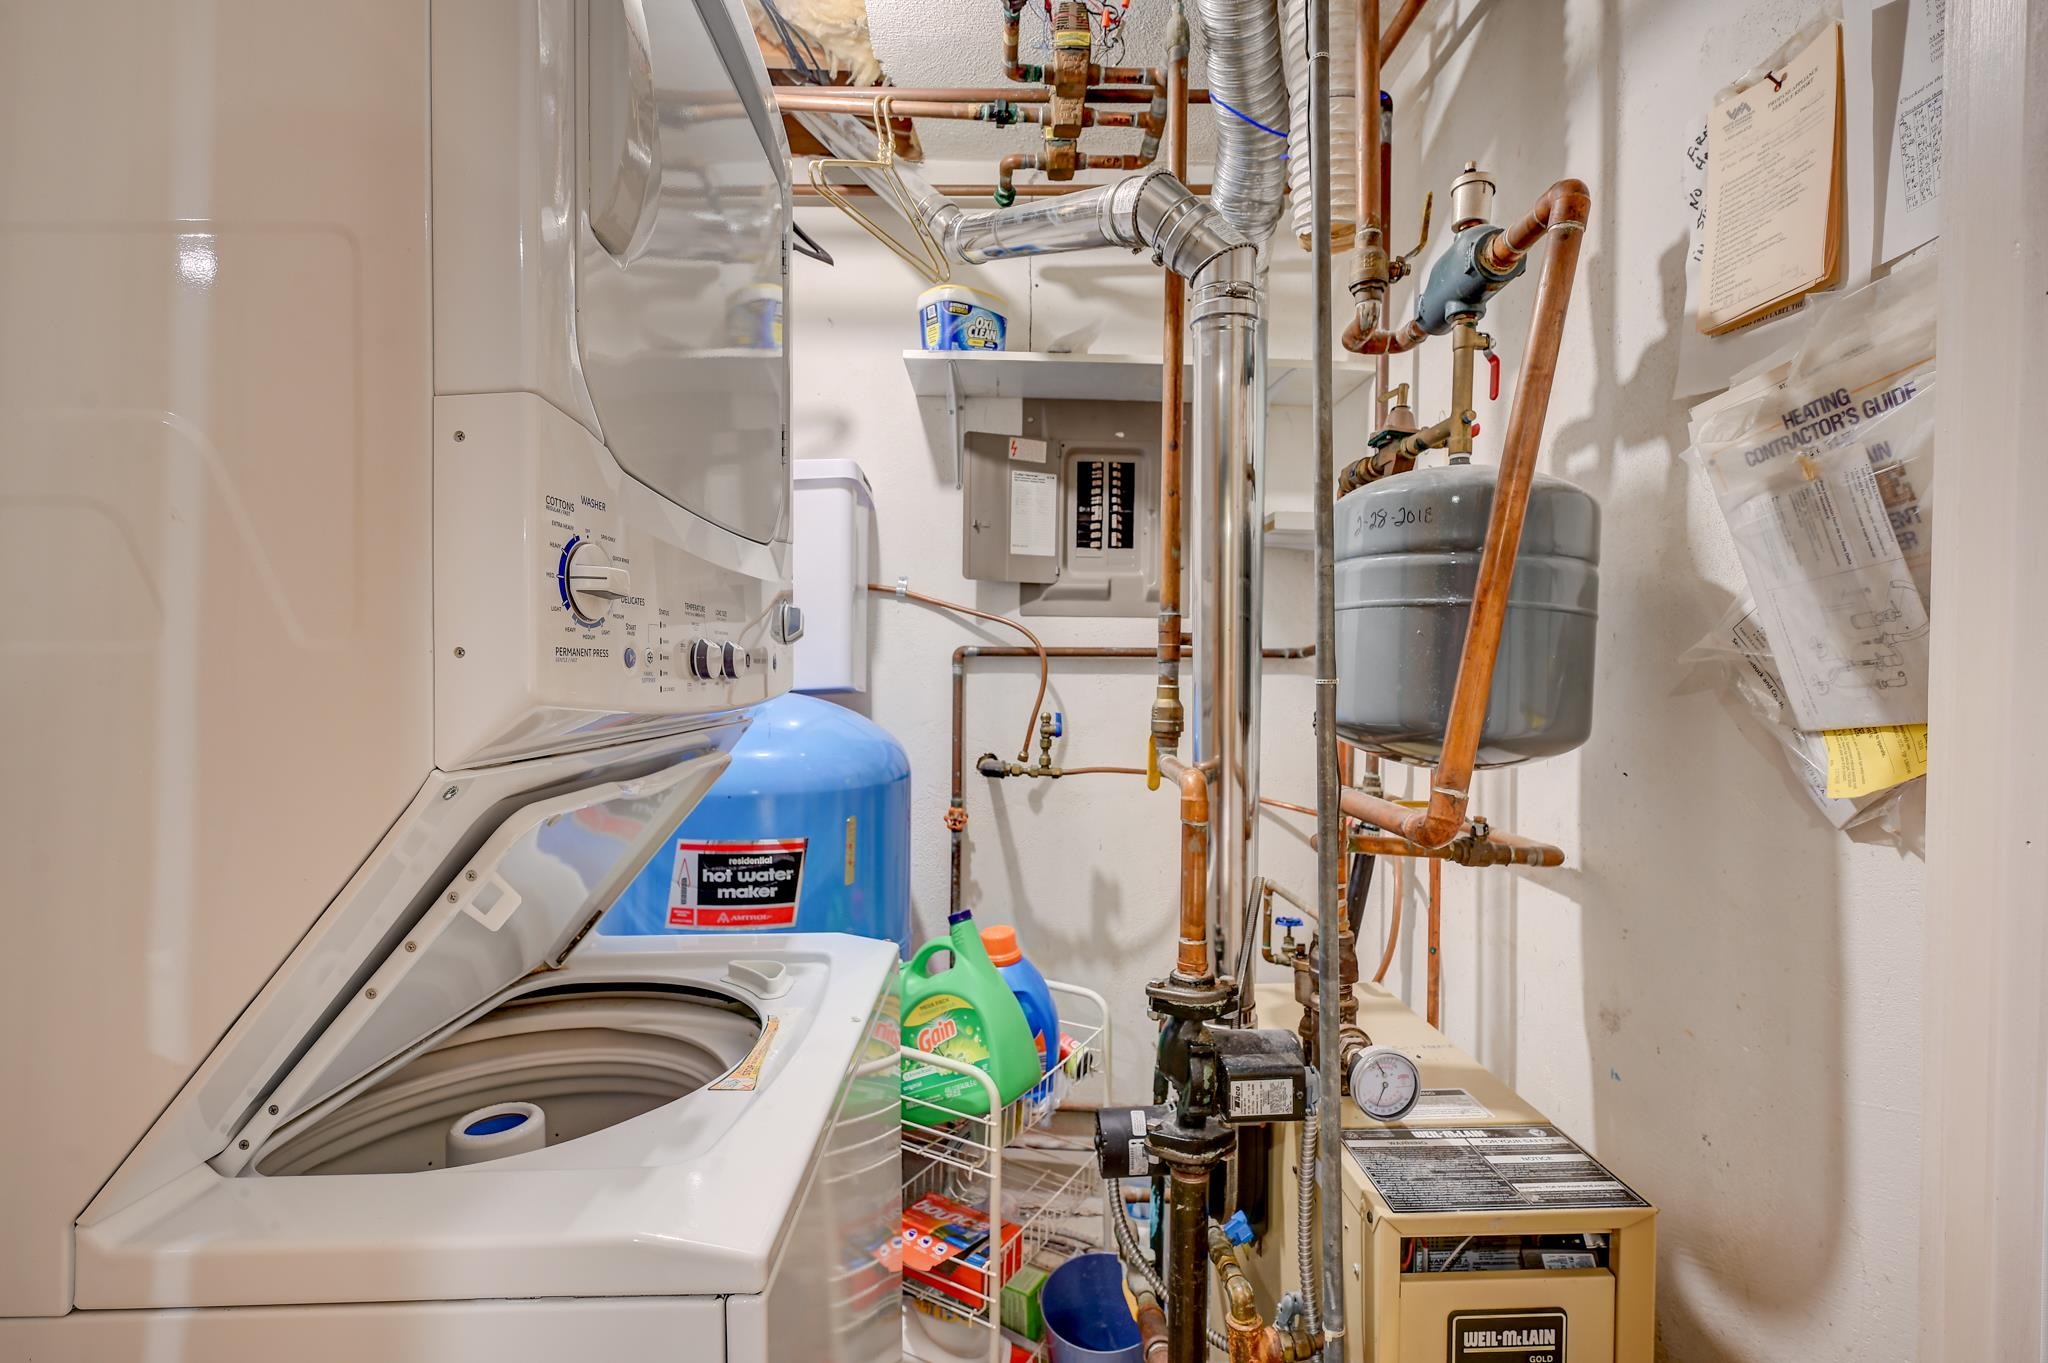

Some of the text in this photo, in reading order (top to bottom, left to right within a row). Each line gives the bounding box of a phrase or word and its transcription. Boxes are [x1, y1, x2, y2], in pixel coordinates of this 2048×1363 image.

[975, 316, 993, 329] OXI
[967, 324, 997, 340] CLEAN
[1782, 388, 1852, 430] HEATING
[1745, 407, 1860, 468] CONTRACTOR'S
[545, 495, 606, 512] COTTONS WASHER
[551, 520, 575, 531] EXTRA HEAVY
[549, 541, 562, 549] HEAVY
[621, 596, 645, 607] DELICATES
[625, 622, 637, 631] START
[555, 646, 609, 658] PERMANENT PRESS
[728, 855, 773, 866] residential
[702, 868, 794, 883] hot water
[717, 885, 778, 899] maker
[918, 1019, 957, 1053] Gain
[1529, 1355, 1553, 1363] GOLD
